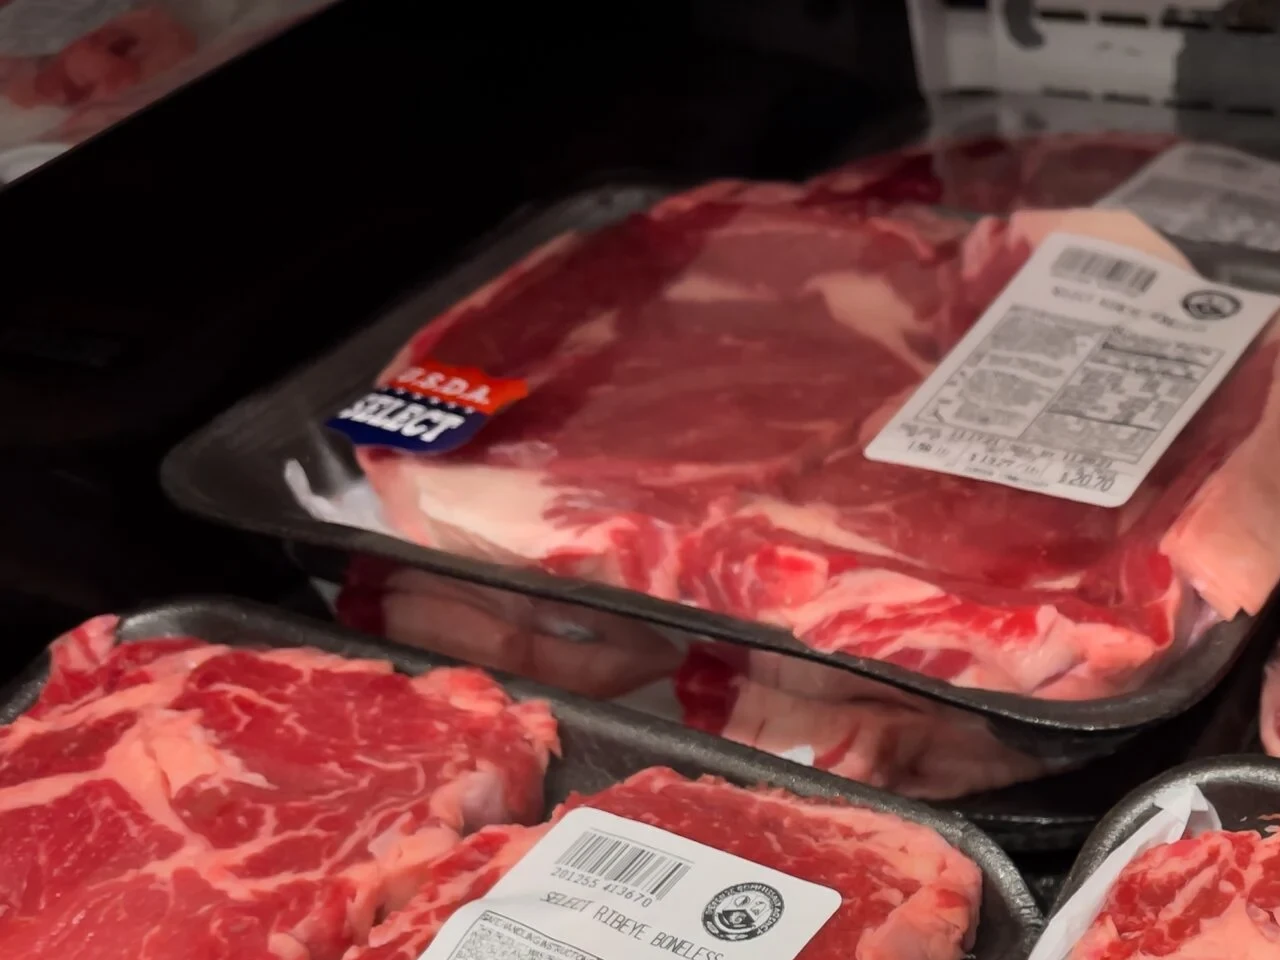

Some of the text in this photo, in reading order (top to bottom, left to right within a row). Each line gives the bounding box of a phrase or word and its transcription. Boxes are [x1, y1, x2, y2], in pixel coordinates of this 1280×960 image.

[338, 393, 465, 443] SELECT
[539, 890, 594, 912] SELECT
[593, 905, 650, 940] RIBEYE
